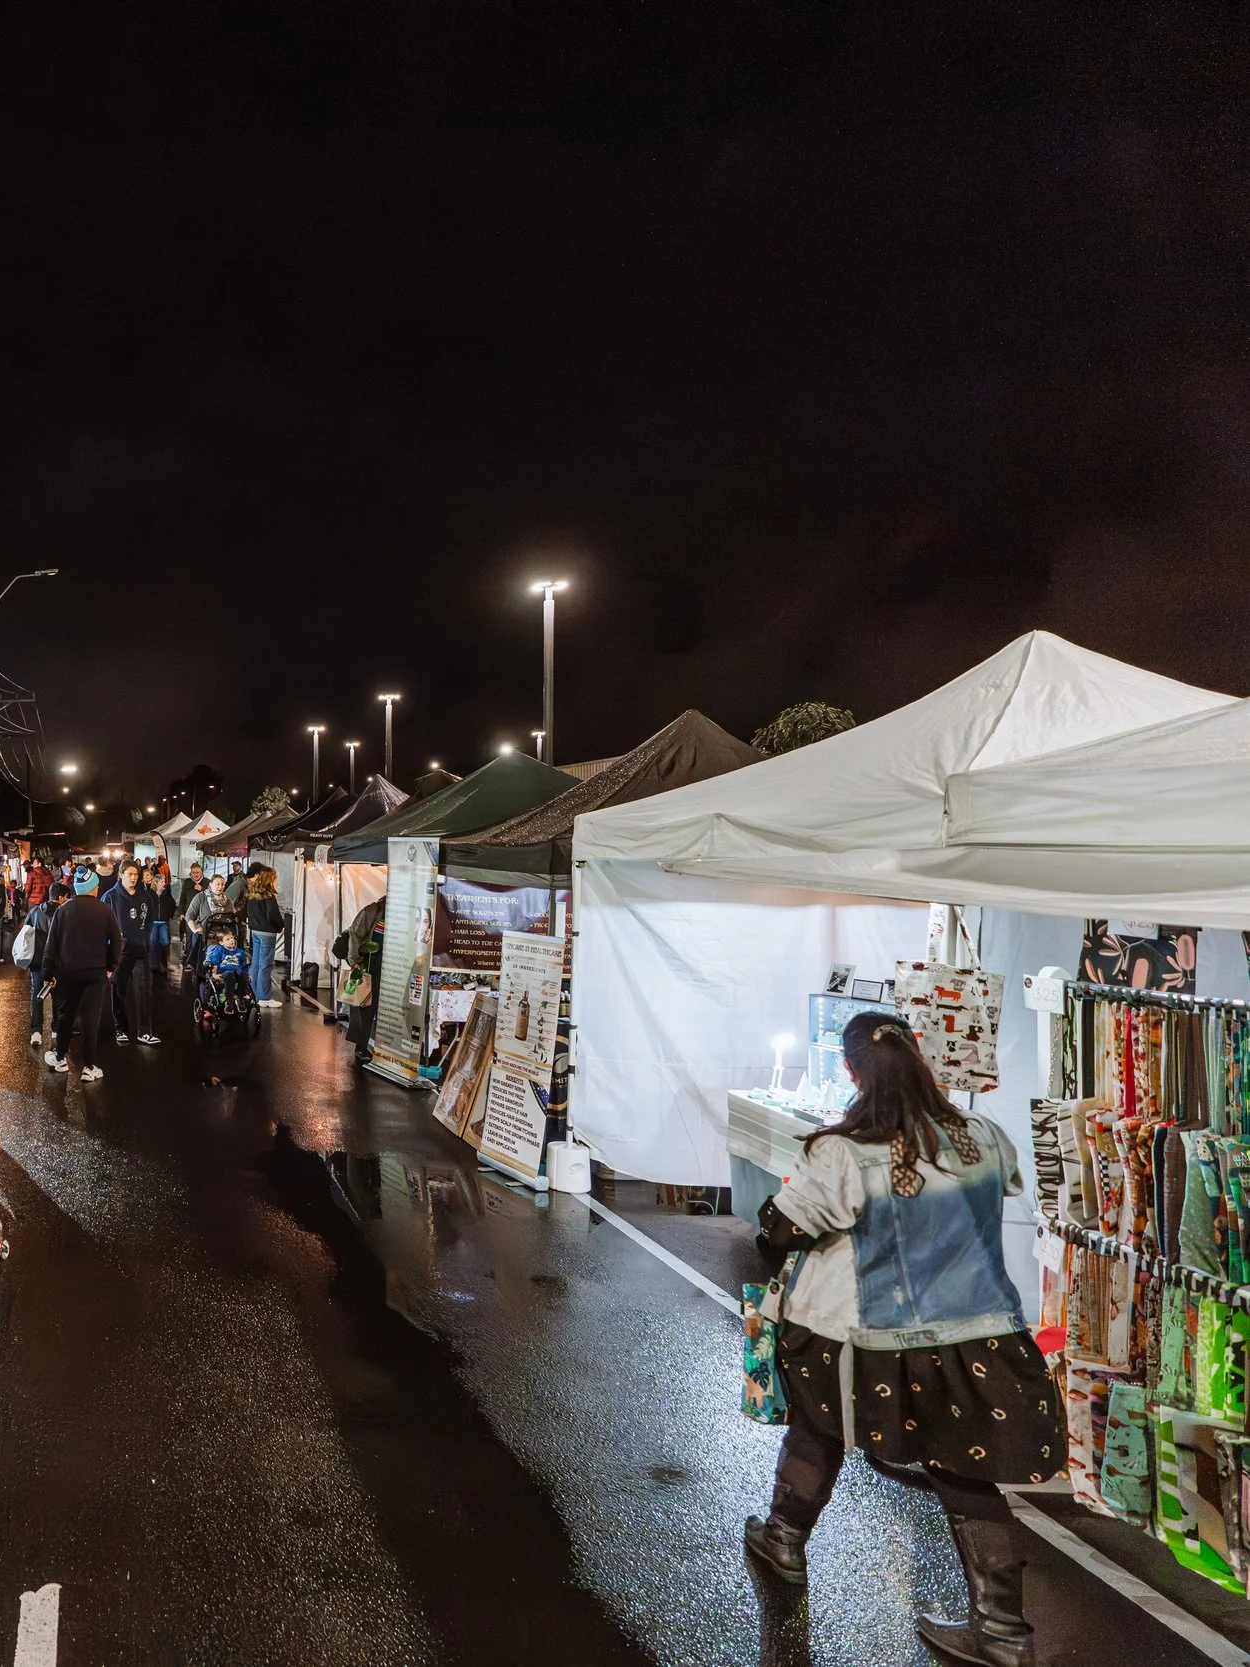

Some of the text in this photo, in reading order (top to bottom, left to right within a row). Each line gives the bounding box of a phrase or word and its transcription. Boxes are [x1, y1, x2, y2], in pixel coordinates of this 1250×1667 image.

[447, 893, 497, 904] TREATMENTS
[492, 1092, 504, 1101] TREATS
[491, 1099, 505, 1109] REPAIRS
[490, 1107, 505, 1117] REDUCES
[489, 1114, 500, 1122] STOPS
[500, 1119, 511, 1127] SCALP
[522, 1128, 537, 1138] ITCHING
[488, 1122, 504, 1132] EXTENDS
[512, 1132, 526, 1141] GROWTH
[527, 1138, 540, 1148] PHASE
[496, 1140, 518, 1154] APPLICATION
